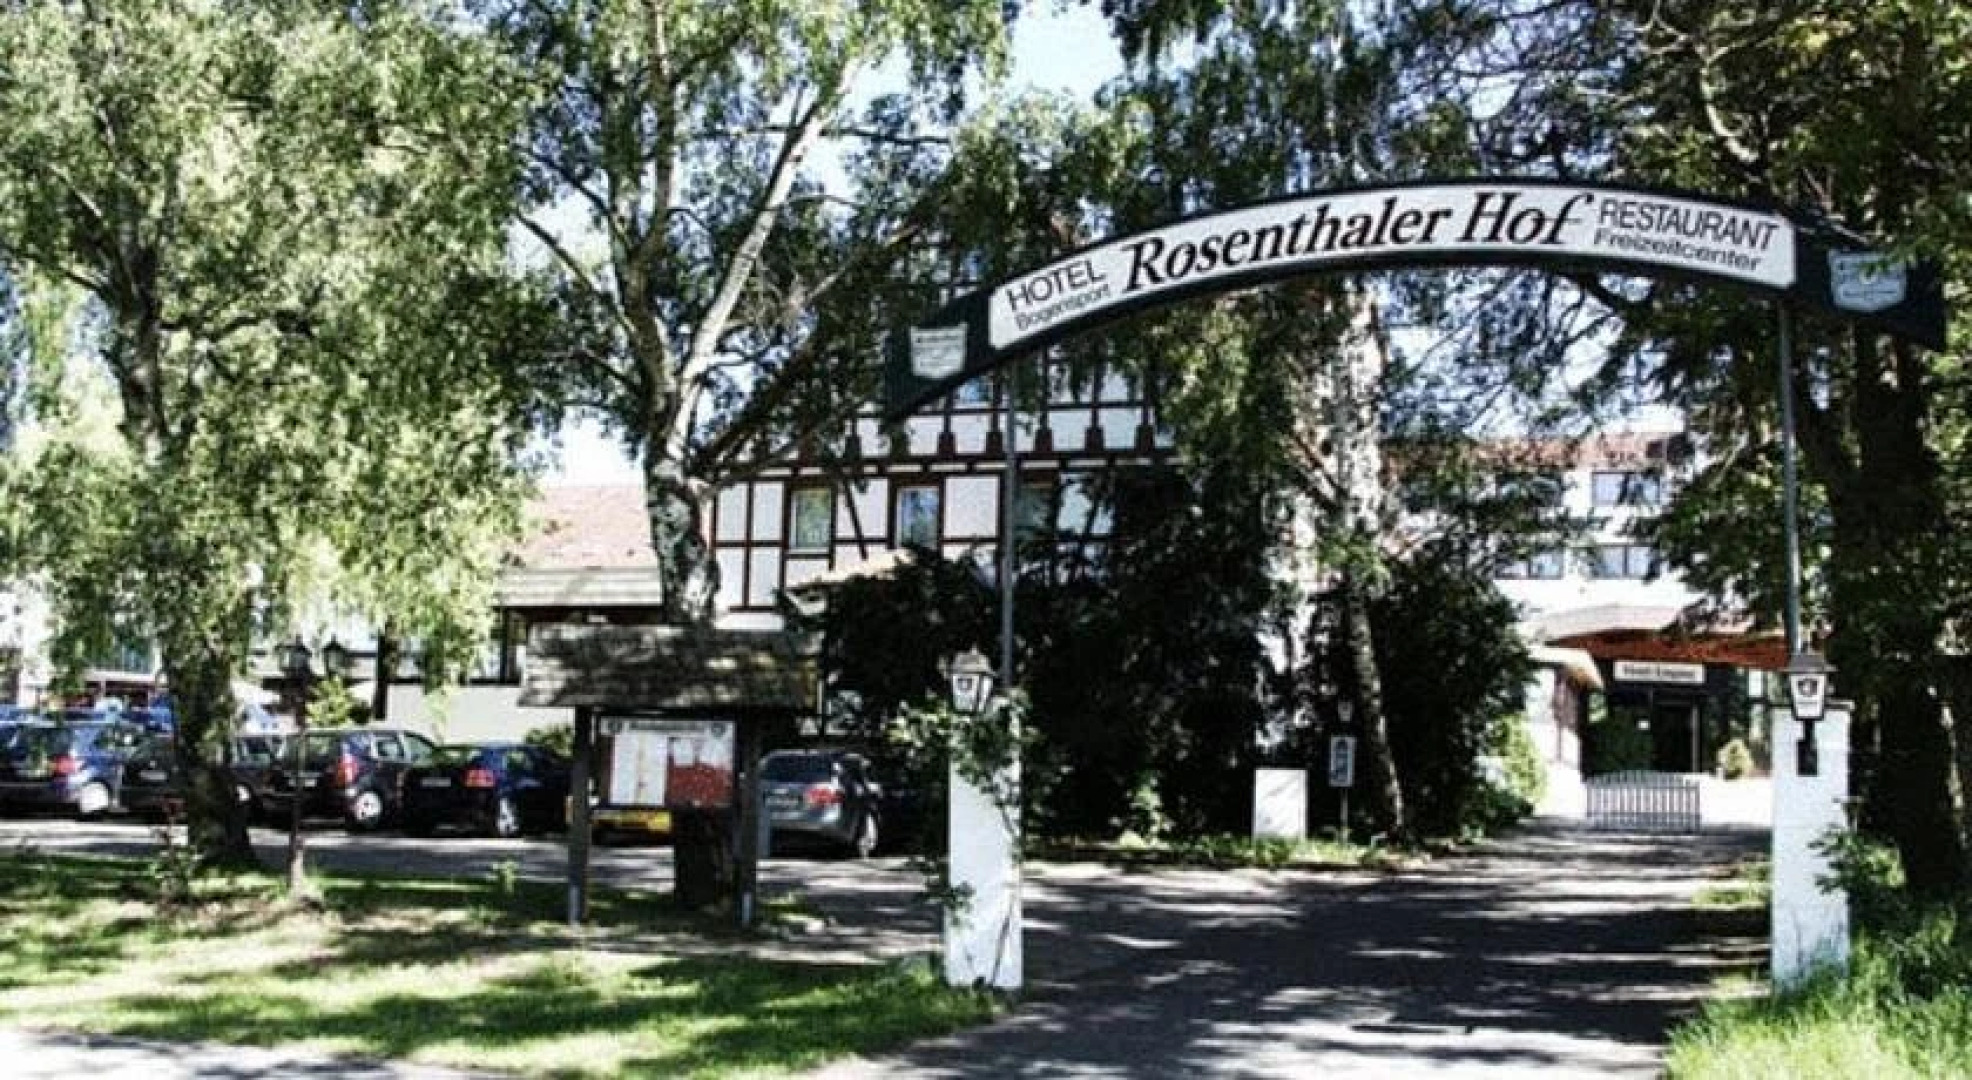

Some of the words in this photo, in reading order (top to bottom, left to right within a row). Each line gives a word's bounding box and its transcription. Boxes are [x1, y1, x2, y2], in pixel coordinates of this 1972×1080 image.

[1122, 196, 1452, 292] Rosenthaler
[1455, 192, 1594, 245] Hof
[1601, 199, 1778, 250] RESTAURANT
[1006, 260, 1106, 312] HOTEL
